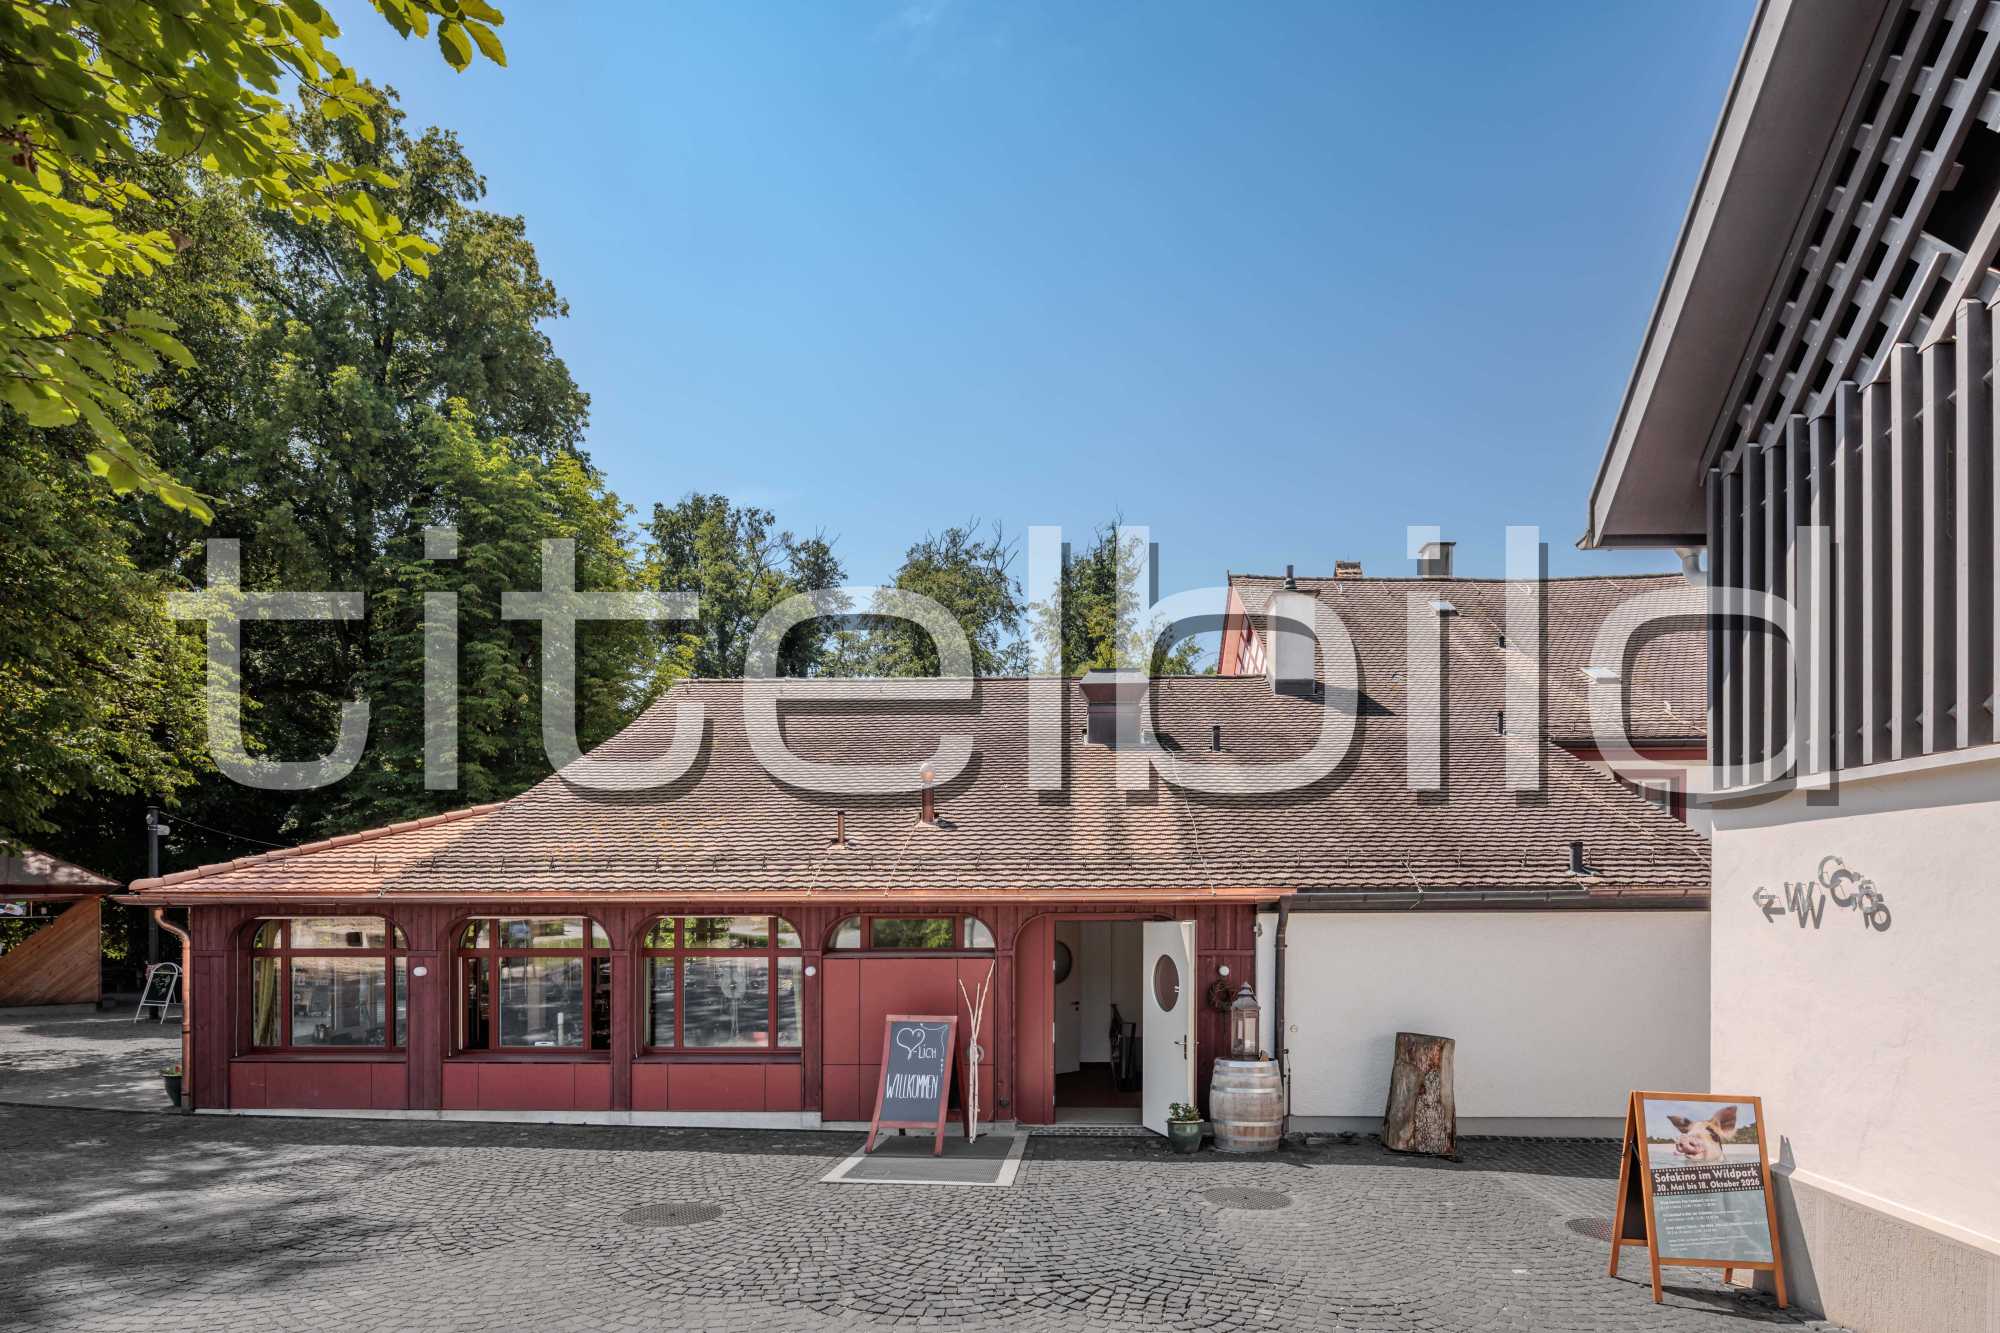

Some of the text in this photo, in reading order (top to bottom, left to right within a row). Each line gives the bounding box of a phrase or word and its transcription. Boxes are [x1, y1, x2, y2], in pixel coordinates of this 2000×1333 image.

[886, 1073, 939, 1099] WILLKOMMEN
[1655, 1167, 1758, 1183] Sofakino im Wildpark
[1656, 1177, 1760, 1192] 30. Mai bis 18. Oktober 2026
